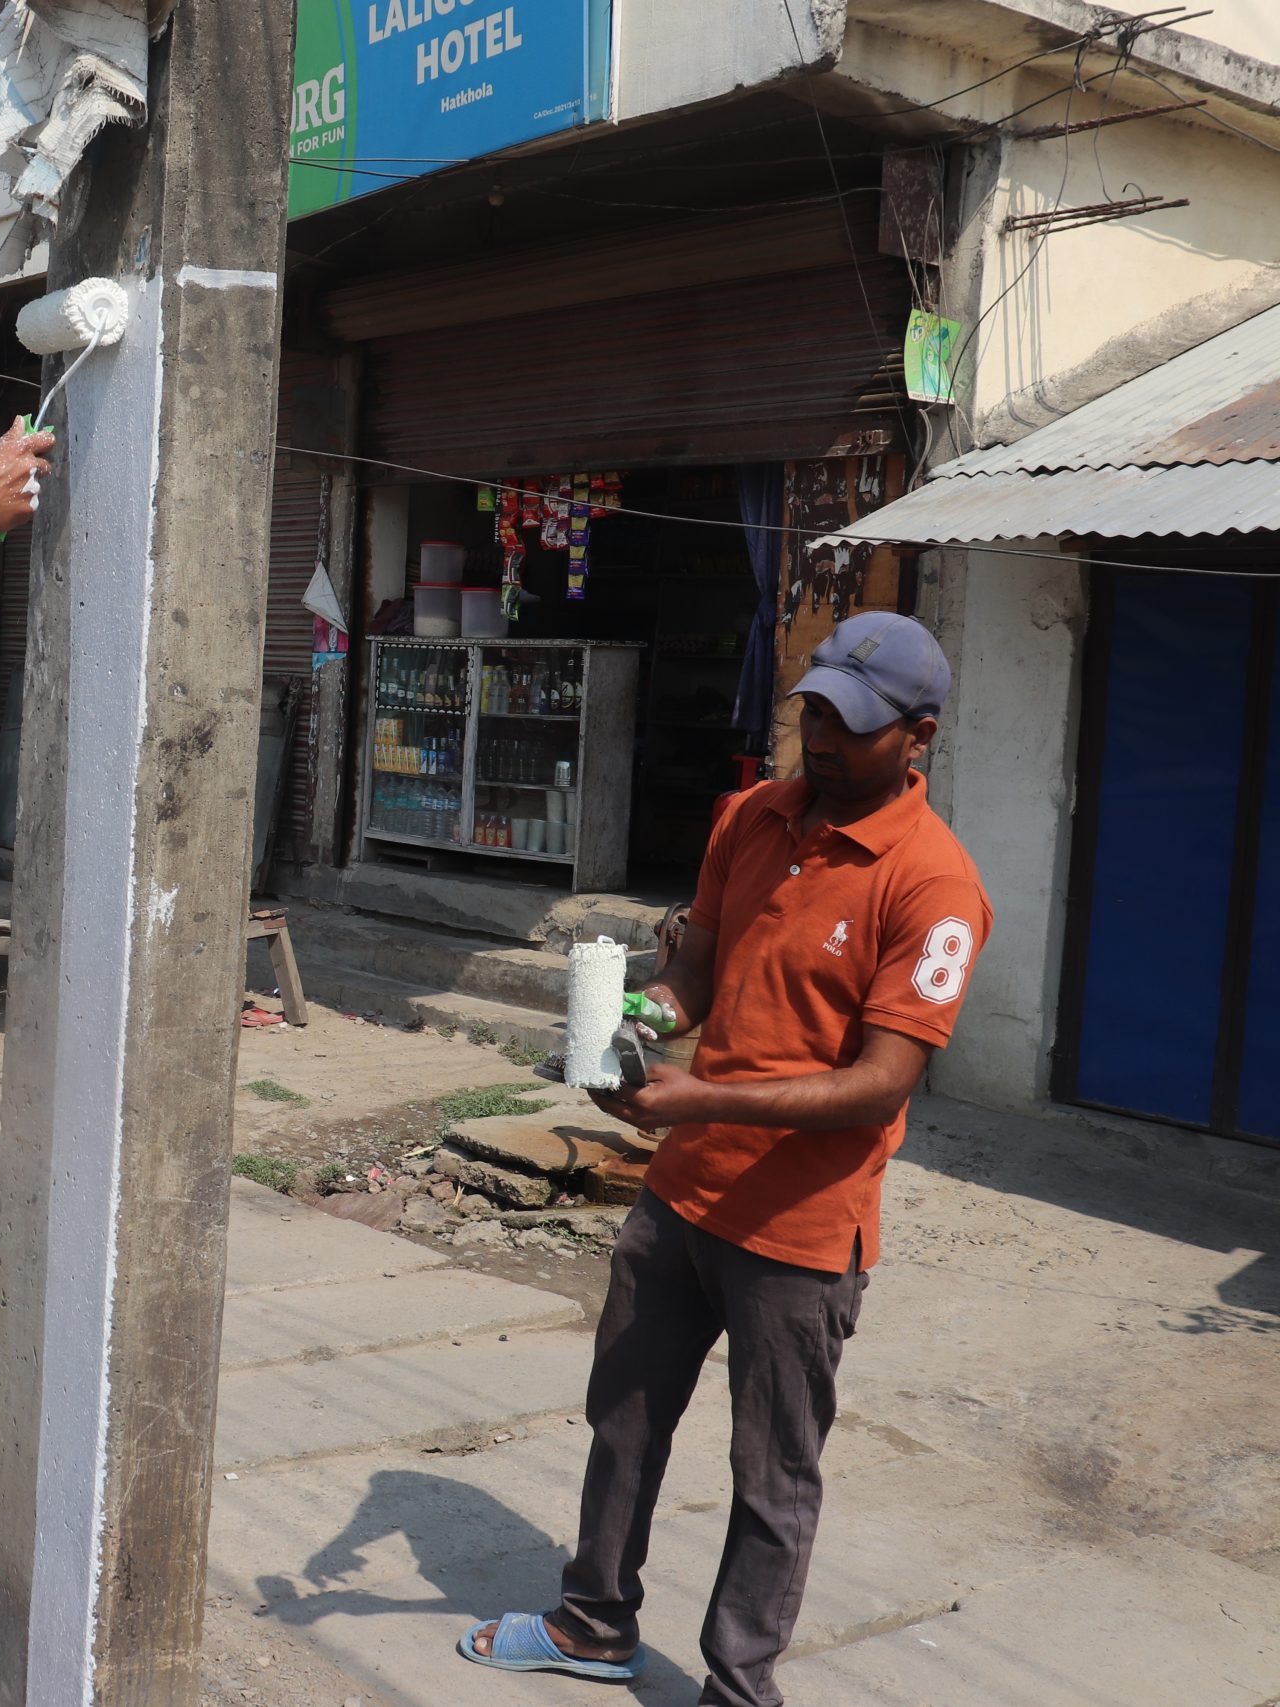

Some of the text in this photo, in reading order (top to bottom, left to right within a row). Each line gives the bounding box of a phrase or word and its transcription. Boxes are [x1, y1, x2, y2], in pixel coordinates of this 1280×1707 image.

[416, 6, 522, 85] HOTEL
[441, 82, 493, 113] Hatkhola
[297, 135, 319, 156] FOR
[322, 125, 344, 147] FUN
[822, 942, 843, 957] POLO
[911, 916, 973, 1004] 8
